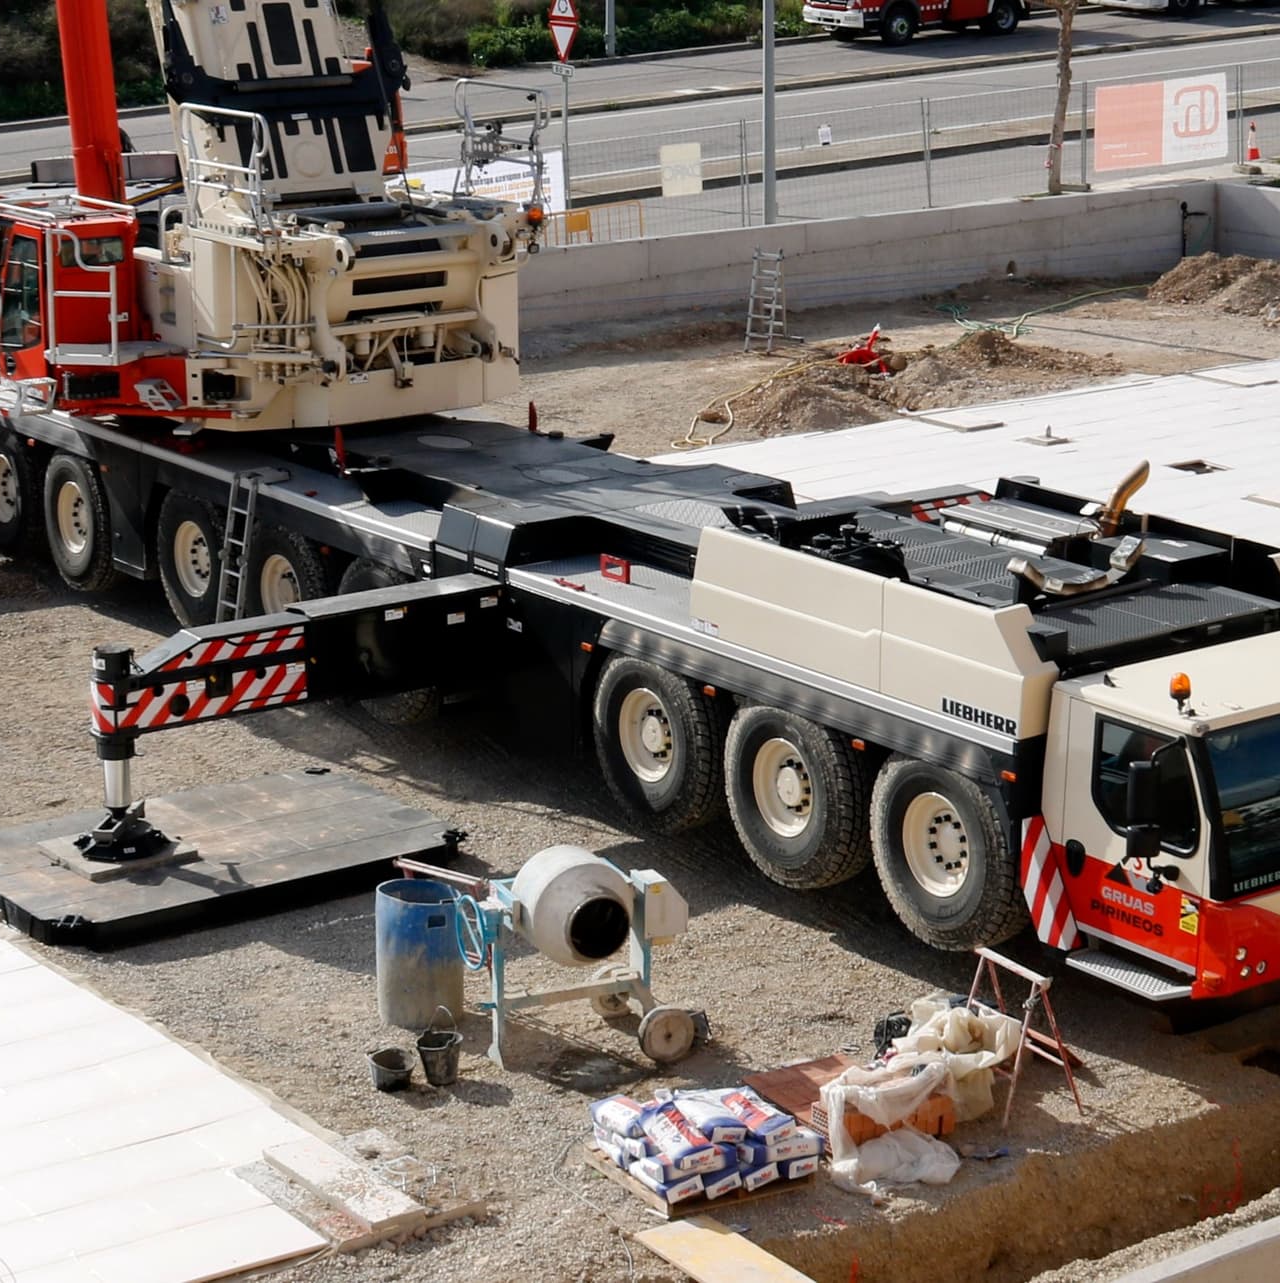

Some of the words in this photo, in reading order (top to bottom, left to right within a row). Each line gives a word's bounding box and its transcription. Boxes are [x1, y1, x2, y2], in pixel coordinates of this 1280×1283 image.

[942, 697, 1017, 736] LIEBHERR
[1090, 899, 1164, 937] PIRINEOS
[1101, 886, 1155, 916] GRUAS
